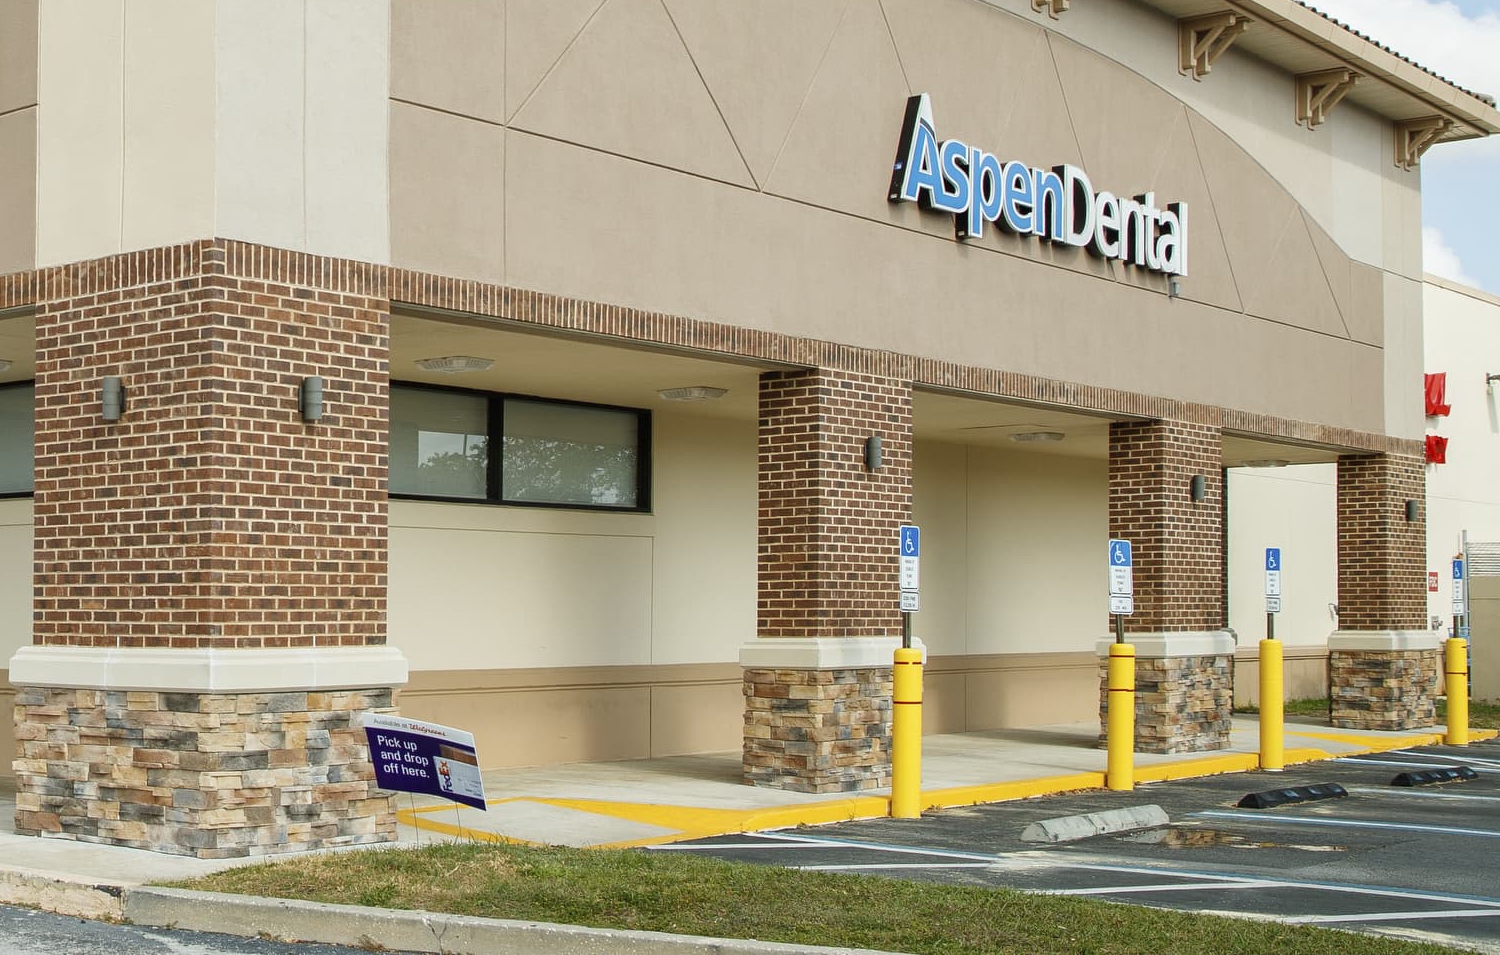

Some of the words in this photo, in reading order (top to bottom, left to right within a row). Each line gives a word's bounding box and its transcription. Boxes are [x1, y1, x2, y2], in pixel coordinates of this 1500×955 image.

[377, 734, 402, 749] Pick
[404, 740, 418, 753] up
[380, 750, 402, 762] and
[403, 751, 429, 767] drop
[383, 762, 399, 774] off
[401, 763, 430, 779] here.
